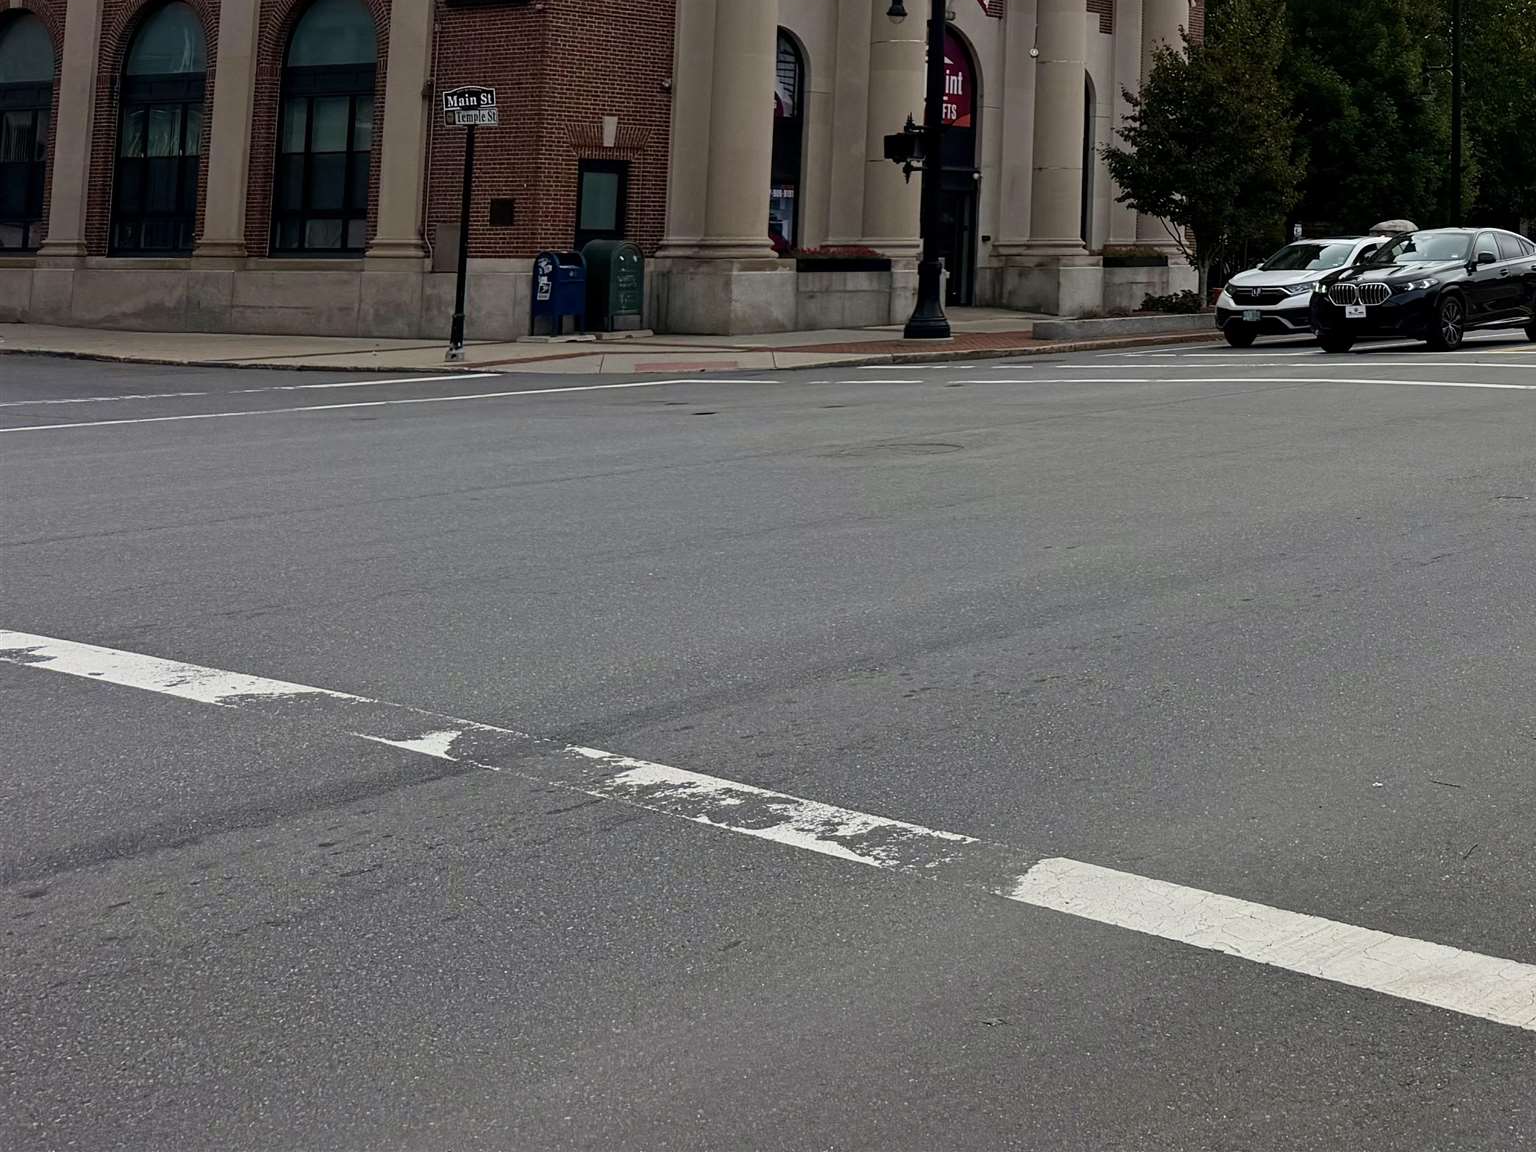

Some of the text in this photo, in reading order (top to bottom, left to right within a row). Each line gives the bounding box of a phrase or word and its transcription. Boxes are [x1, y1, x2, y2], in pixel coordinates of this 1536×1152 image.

[944, 69, 963, 96] int
[447, 93, 492, 107] Main St
[456, 110, 497, 124] Temple St
